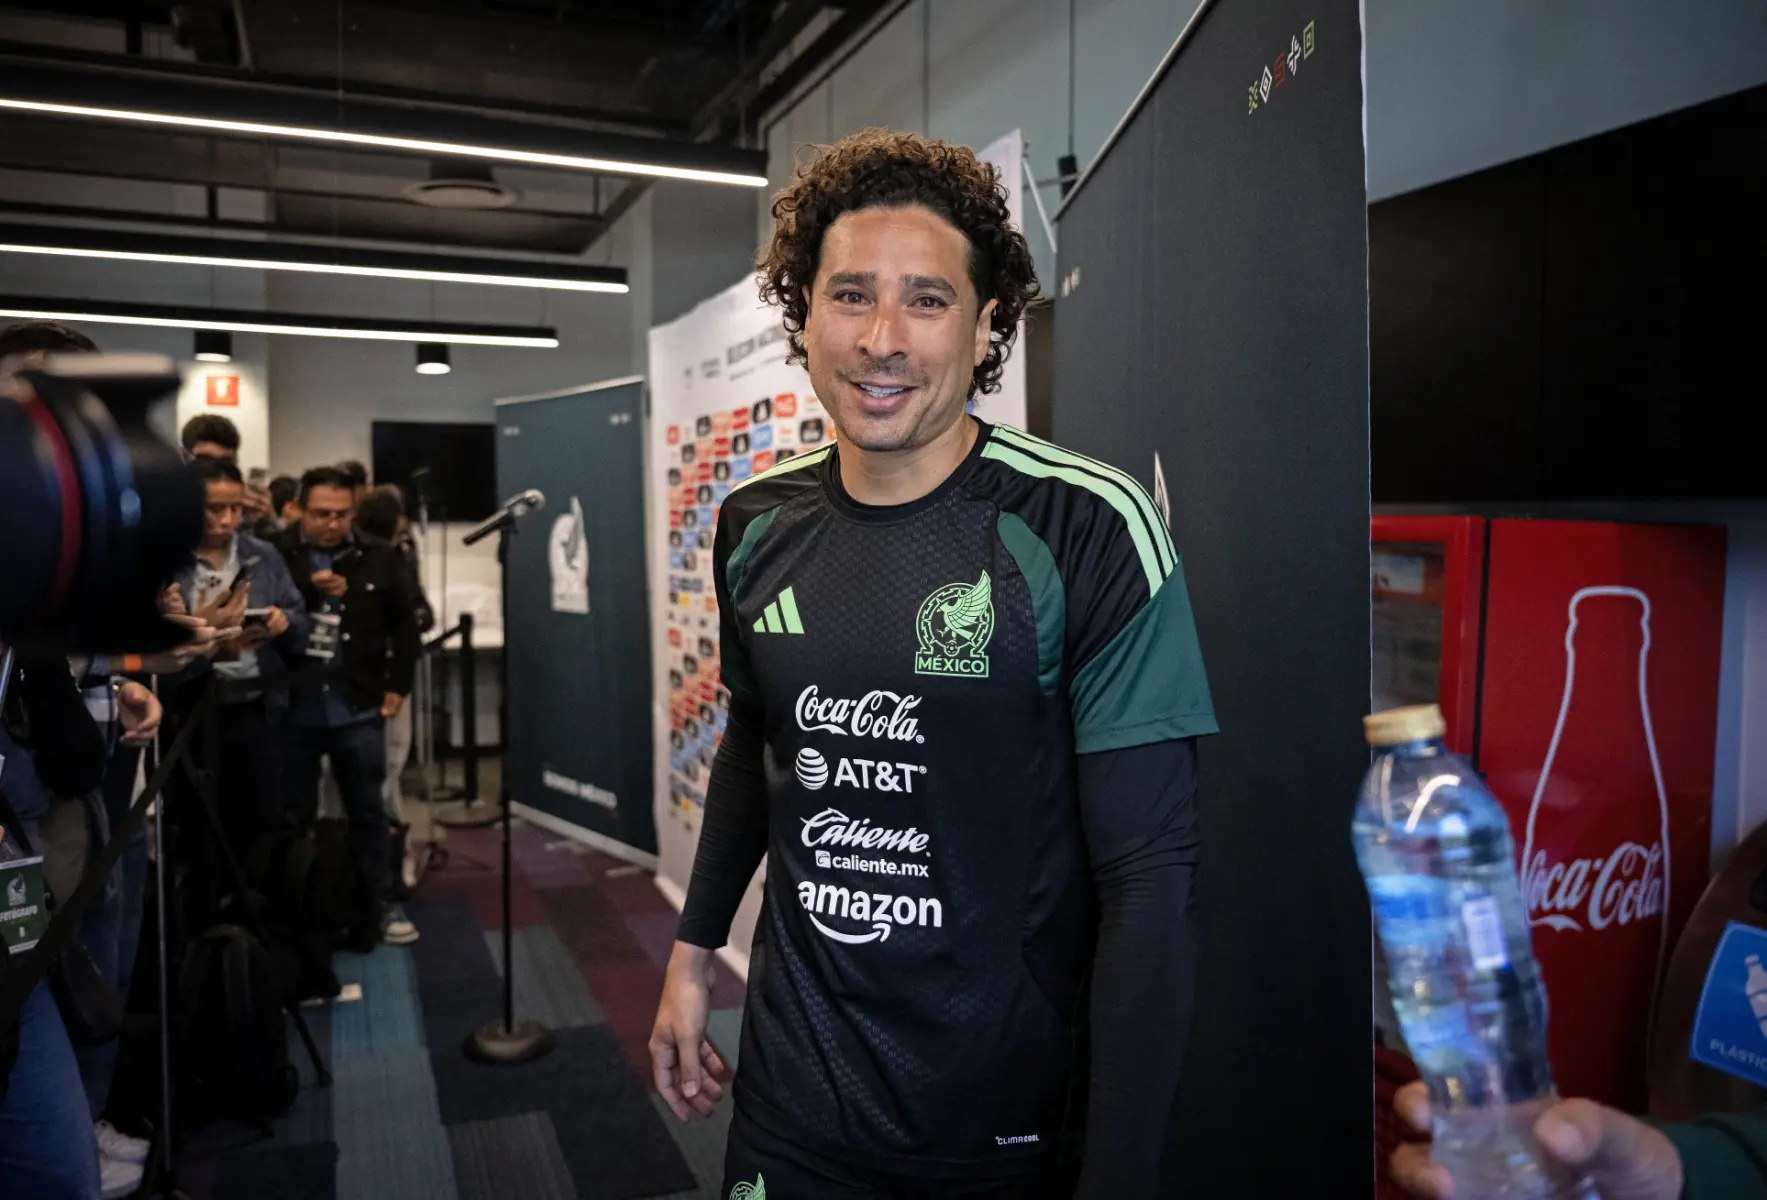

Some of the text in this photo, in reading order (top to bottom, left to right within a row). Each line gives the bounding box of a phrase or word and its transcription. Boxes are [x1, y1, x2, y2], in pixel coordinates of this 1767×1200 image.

[918, 654, 985, 673] MÉXICO
[795, 684, 923, 742] Coca-Cola
[833, 757, 919, 793] AT&T
[800, 807, 930, 853] Caliente
[831, 854, 930, 878] caliente.mx
[1526, 841, 1662, 933] Coca-Cola
[797, 880, 943, 928] amazon
